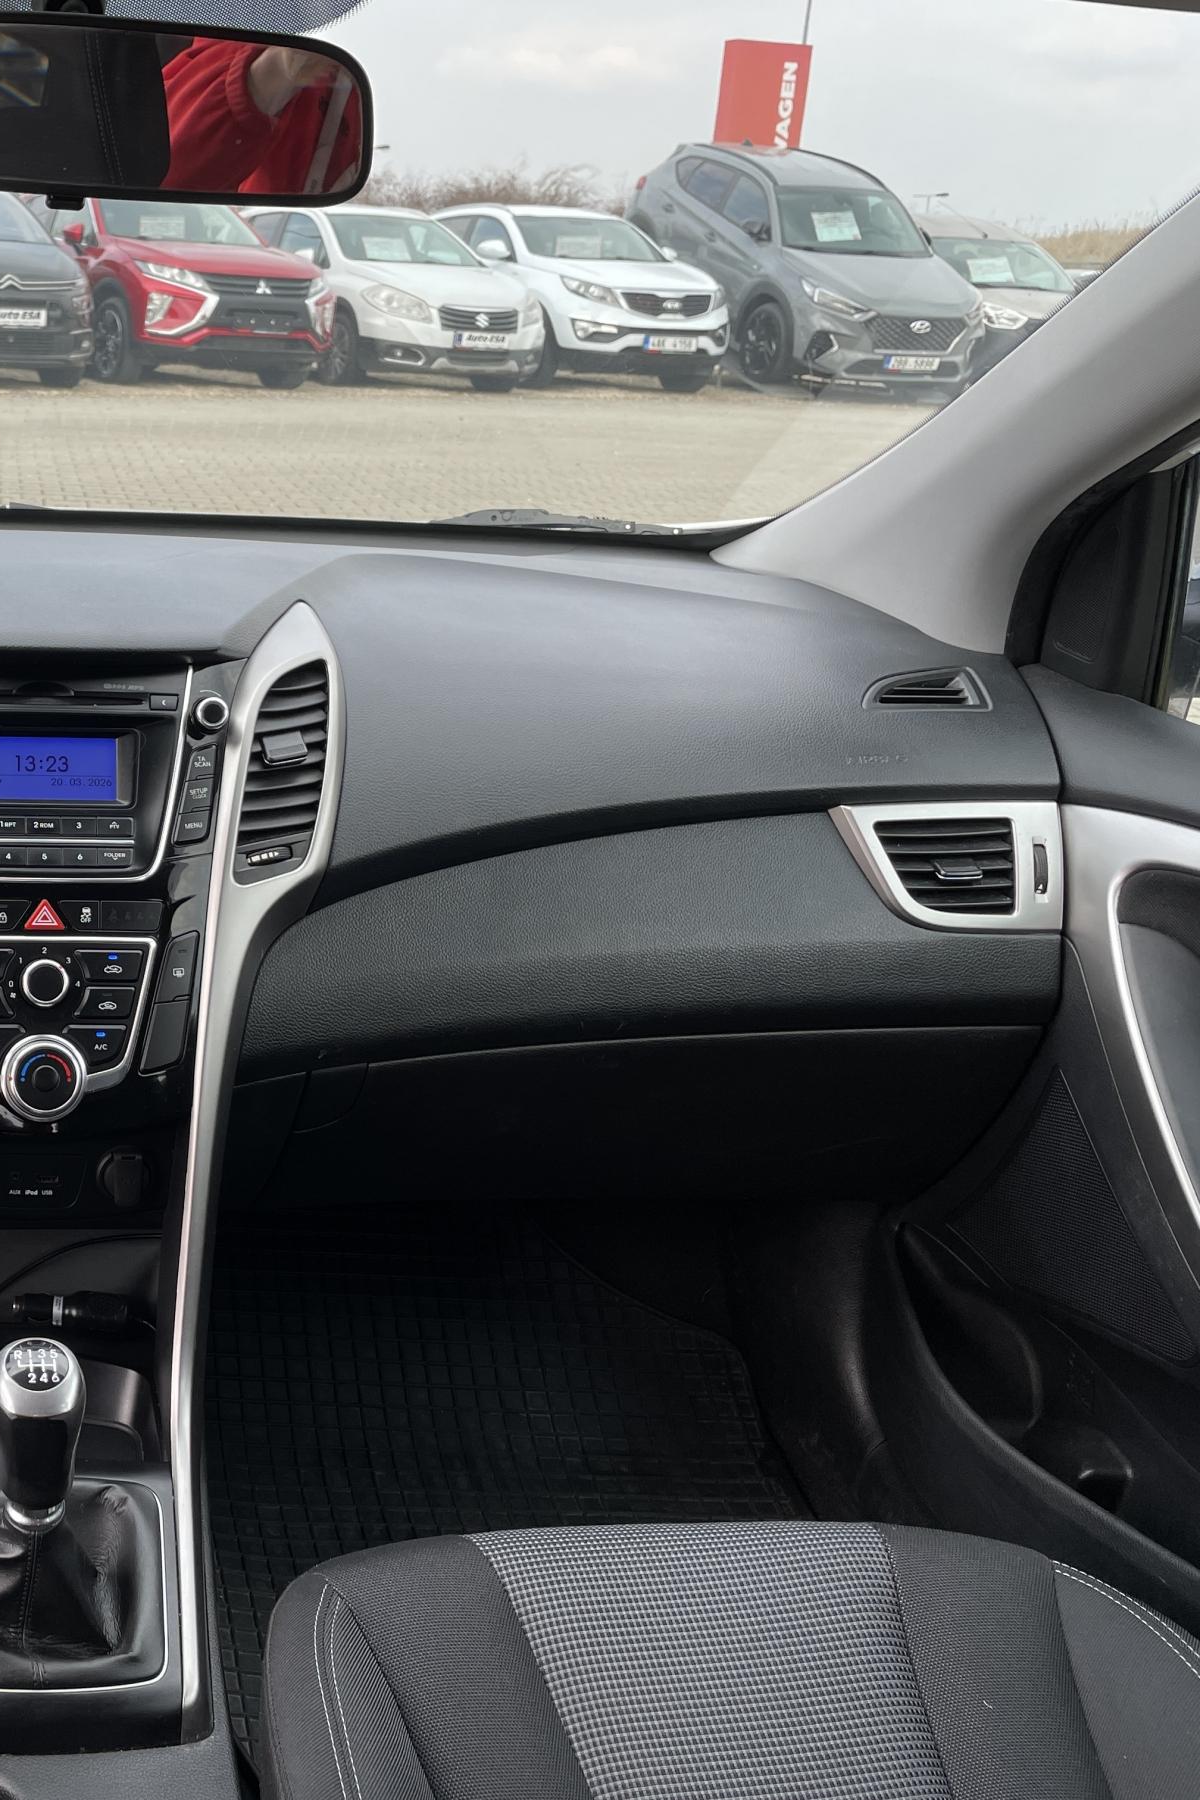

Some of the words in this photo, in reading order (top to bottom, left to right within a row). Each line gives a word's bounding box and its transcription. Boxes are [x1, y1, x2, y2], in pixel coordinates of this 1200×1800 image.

[21, 311, 41, 320] ESA
[15, 754, 69, 773] 13:23
[189, 787, 208, 796] SETUP
[184, 822, 203, 830] MENU
[41, 946, 48, 954] 2
[13, 1349, 22, 1360] R
[27, 1348, 32, 1358] 1
[38, 1348, 46, 1358] 3
[49, 1348, 58, 1359] 5
[27, 1372, 37, 1384] 2
[39, 1372, 48, 1383] 4
[51, 1372, 60, 1383] 6
